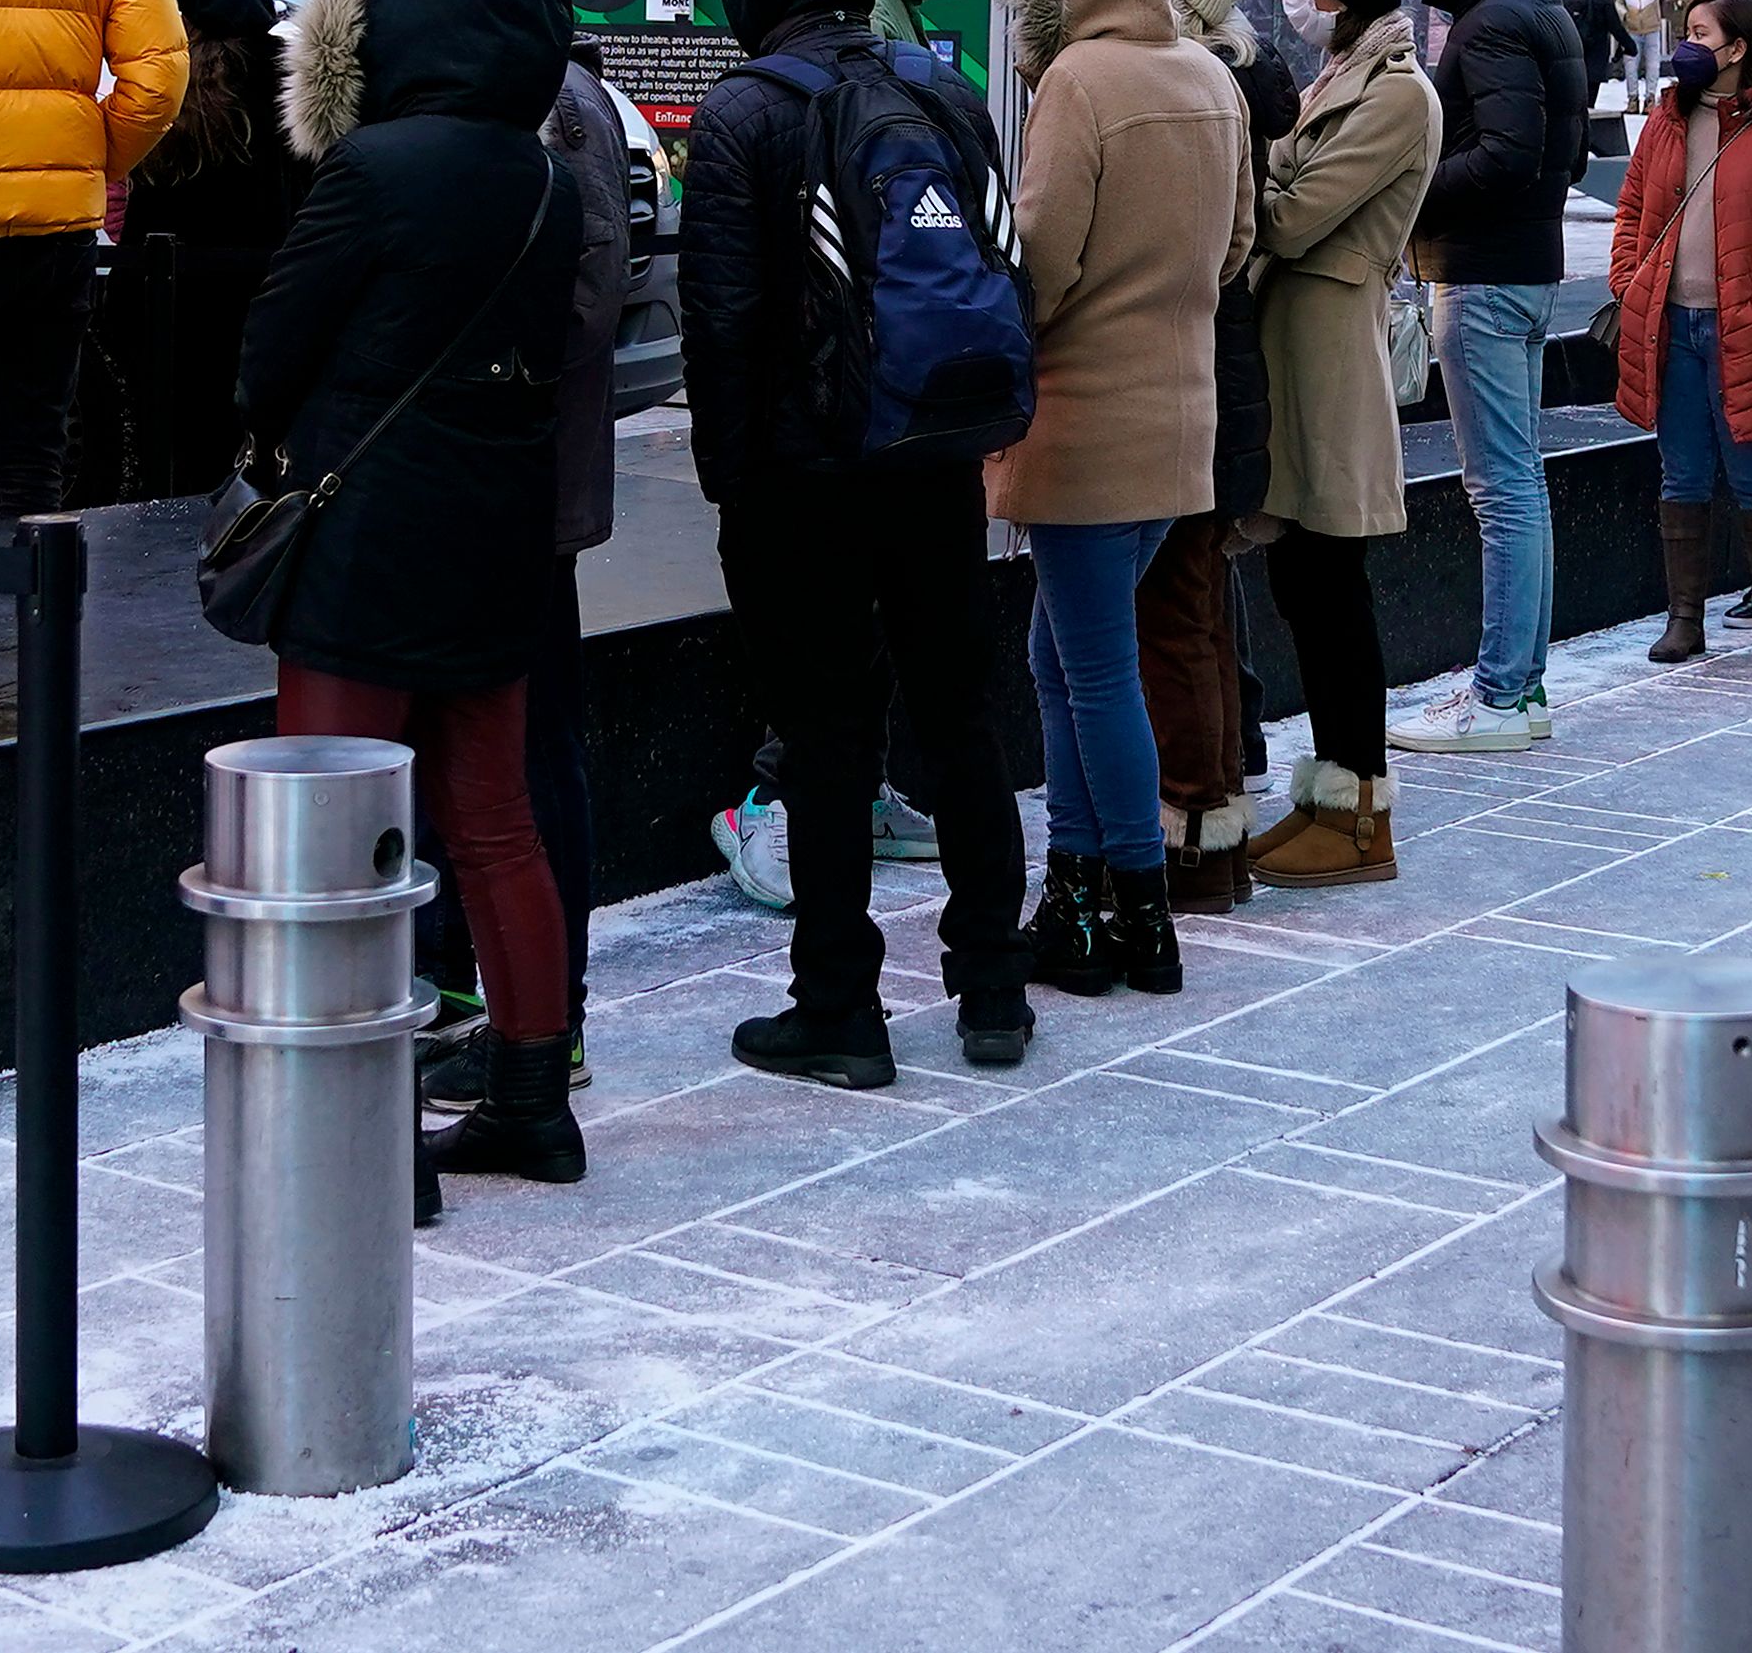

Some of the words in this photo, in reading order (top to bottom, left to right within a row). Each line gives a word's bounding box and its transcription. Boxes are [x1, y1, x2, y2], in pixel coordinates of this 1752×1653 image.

[613, 36, 631, 45] new
[631, 35, 640, 45] to
[671, 46, 699, 57] behind
[699, 47, 713, 58] the
[910, 211, 962, 229] adidas
